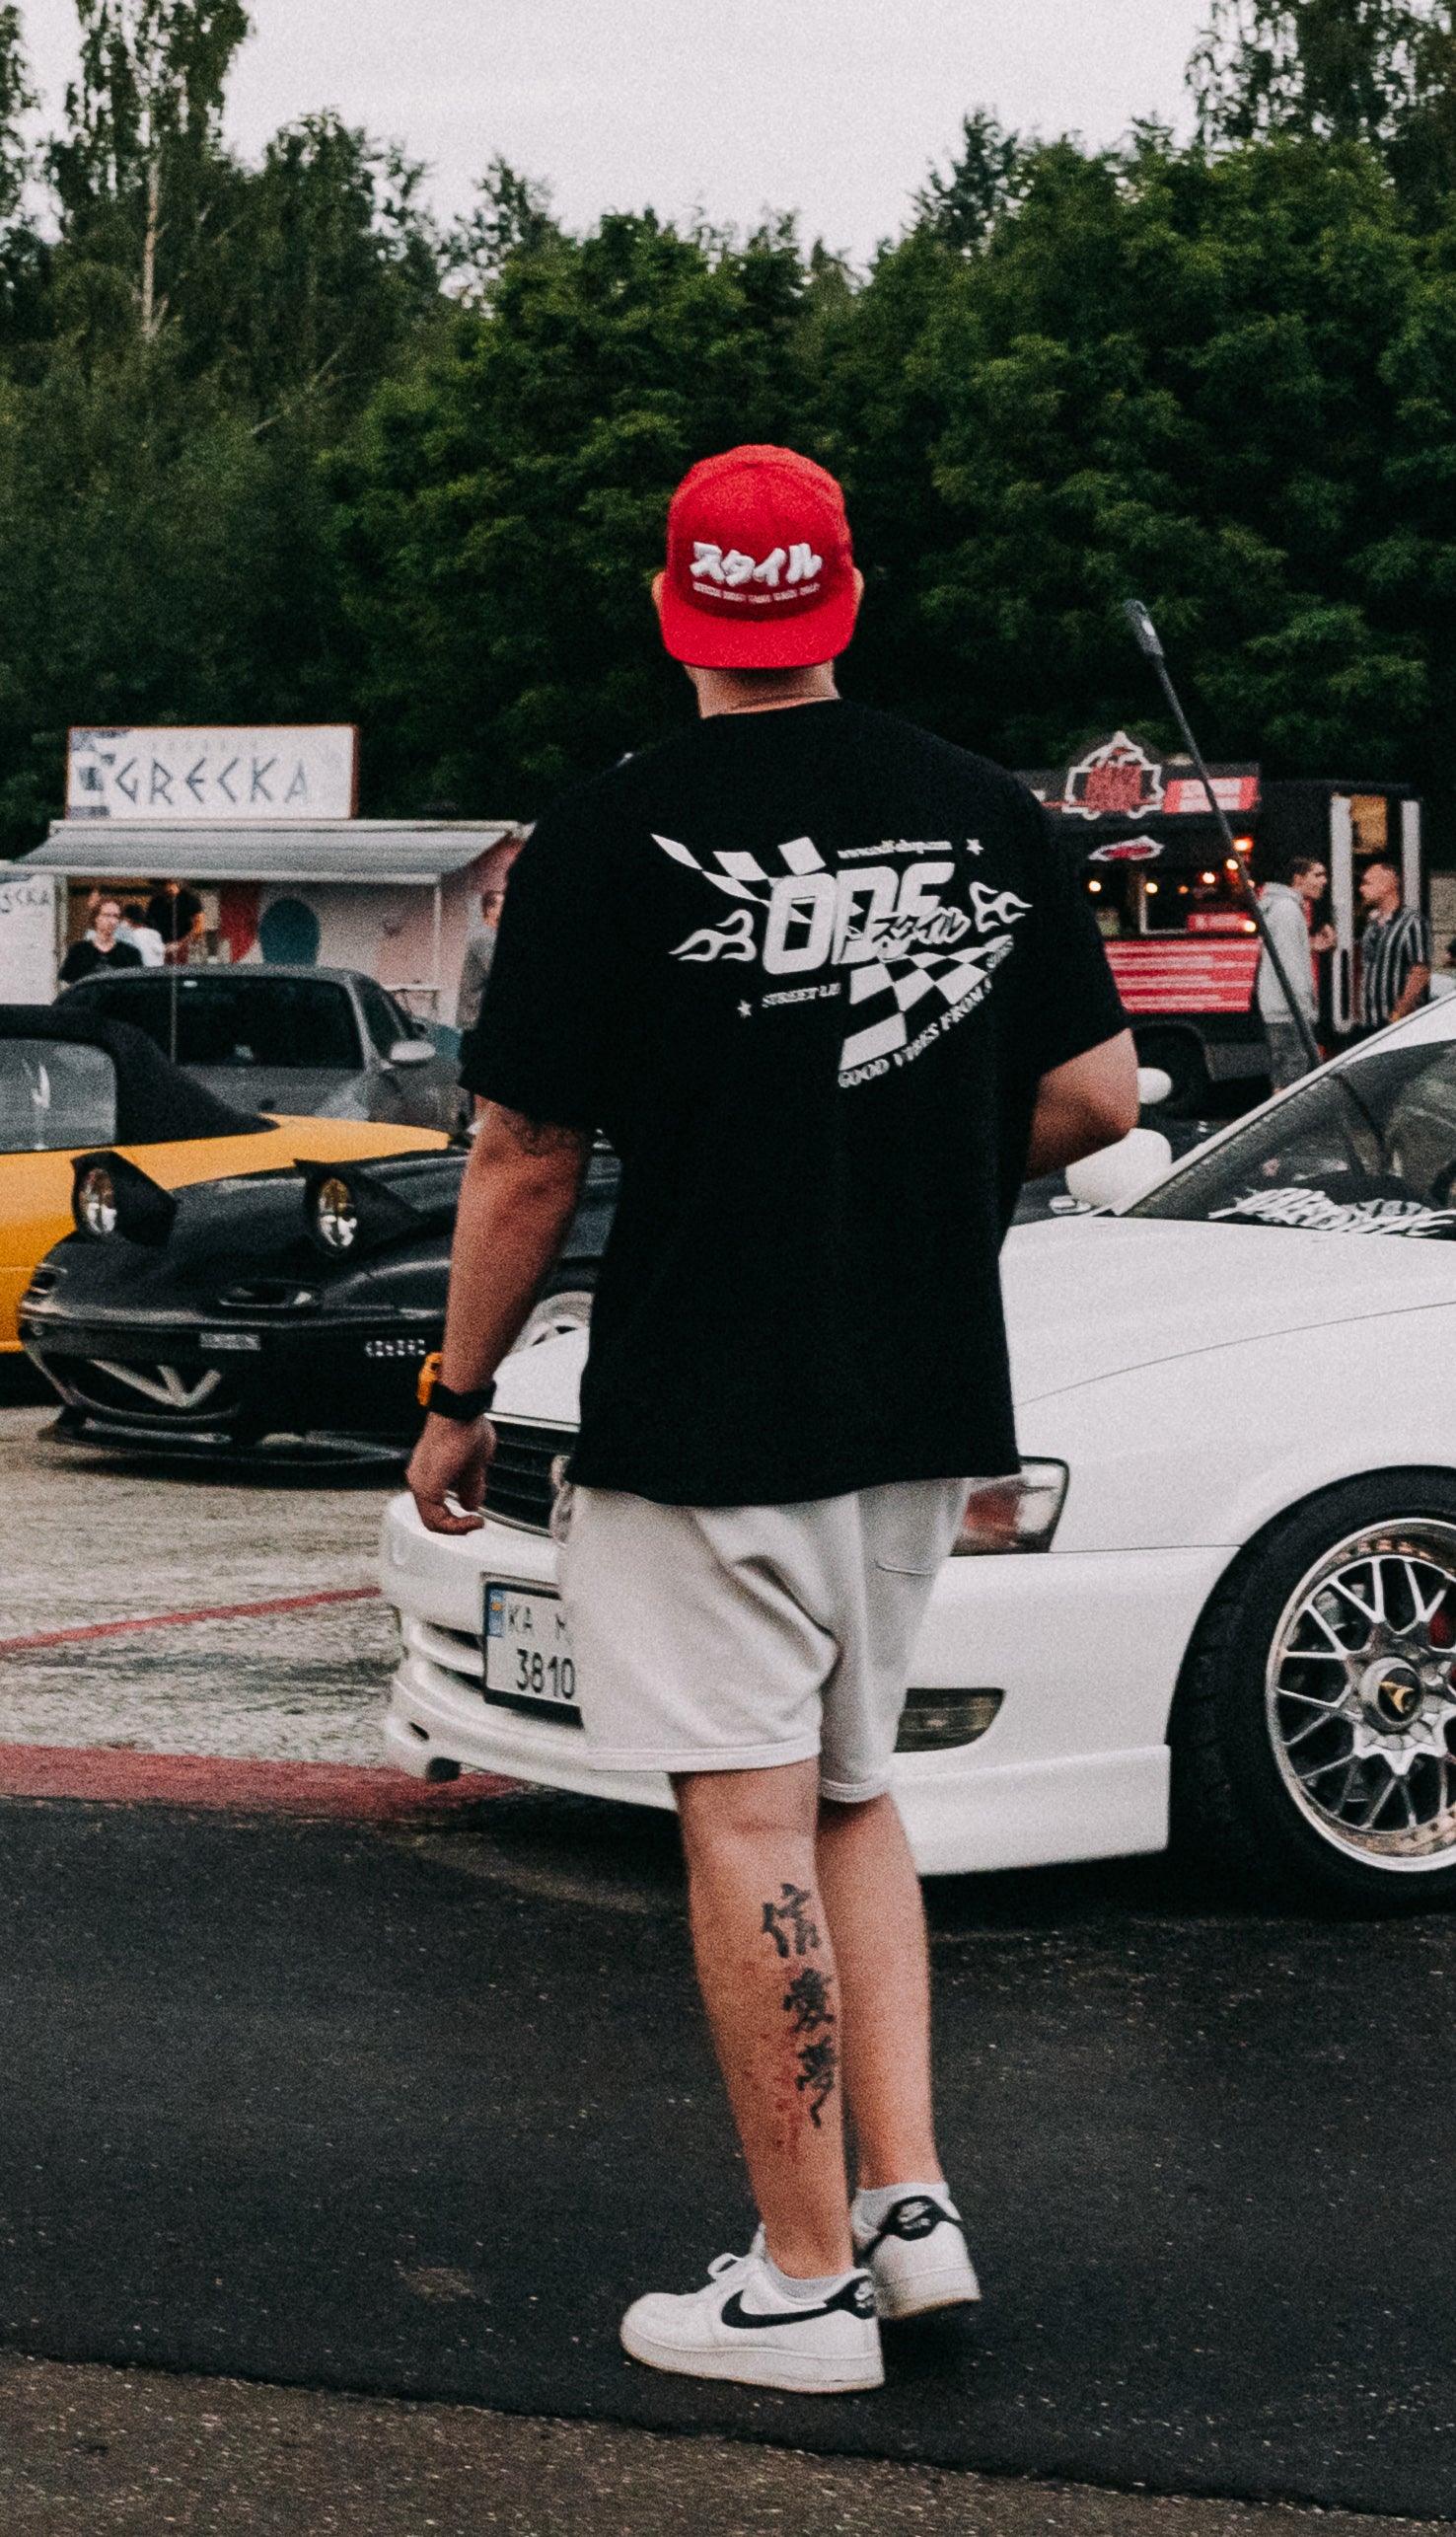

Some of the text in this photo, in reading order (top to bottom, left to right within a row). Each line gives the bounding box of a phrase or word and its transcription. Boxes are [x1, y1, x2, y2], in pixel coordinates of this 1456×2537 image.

[690, 541, 823, 587] スタイル
[114, 757, 309, 805] GRECKA
[837, 1058, 890, 1087] GOOD
[939, 986, 984, 1031] FROM
[516, 1648, 576, 1699] 3810
